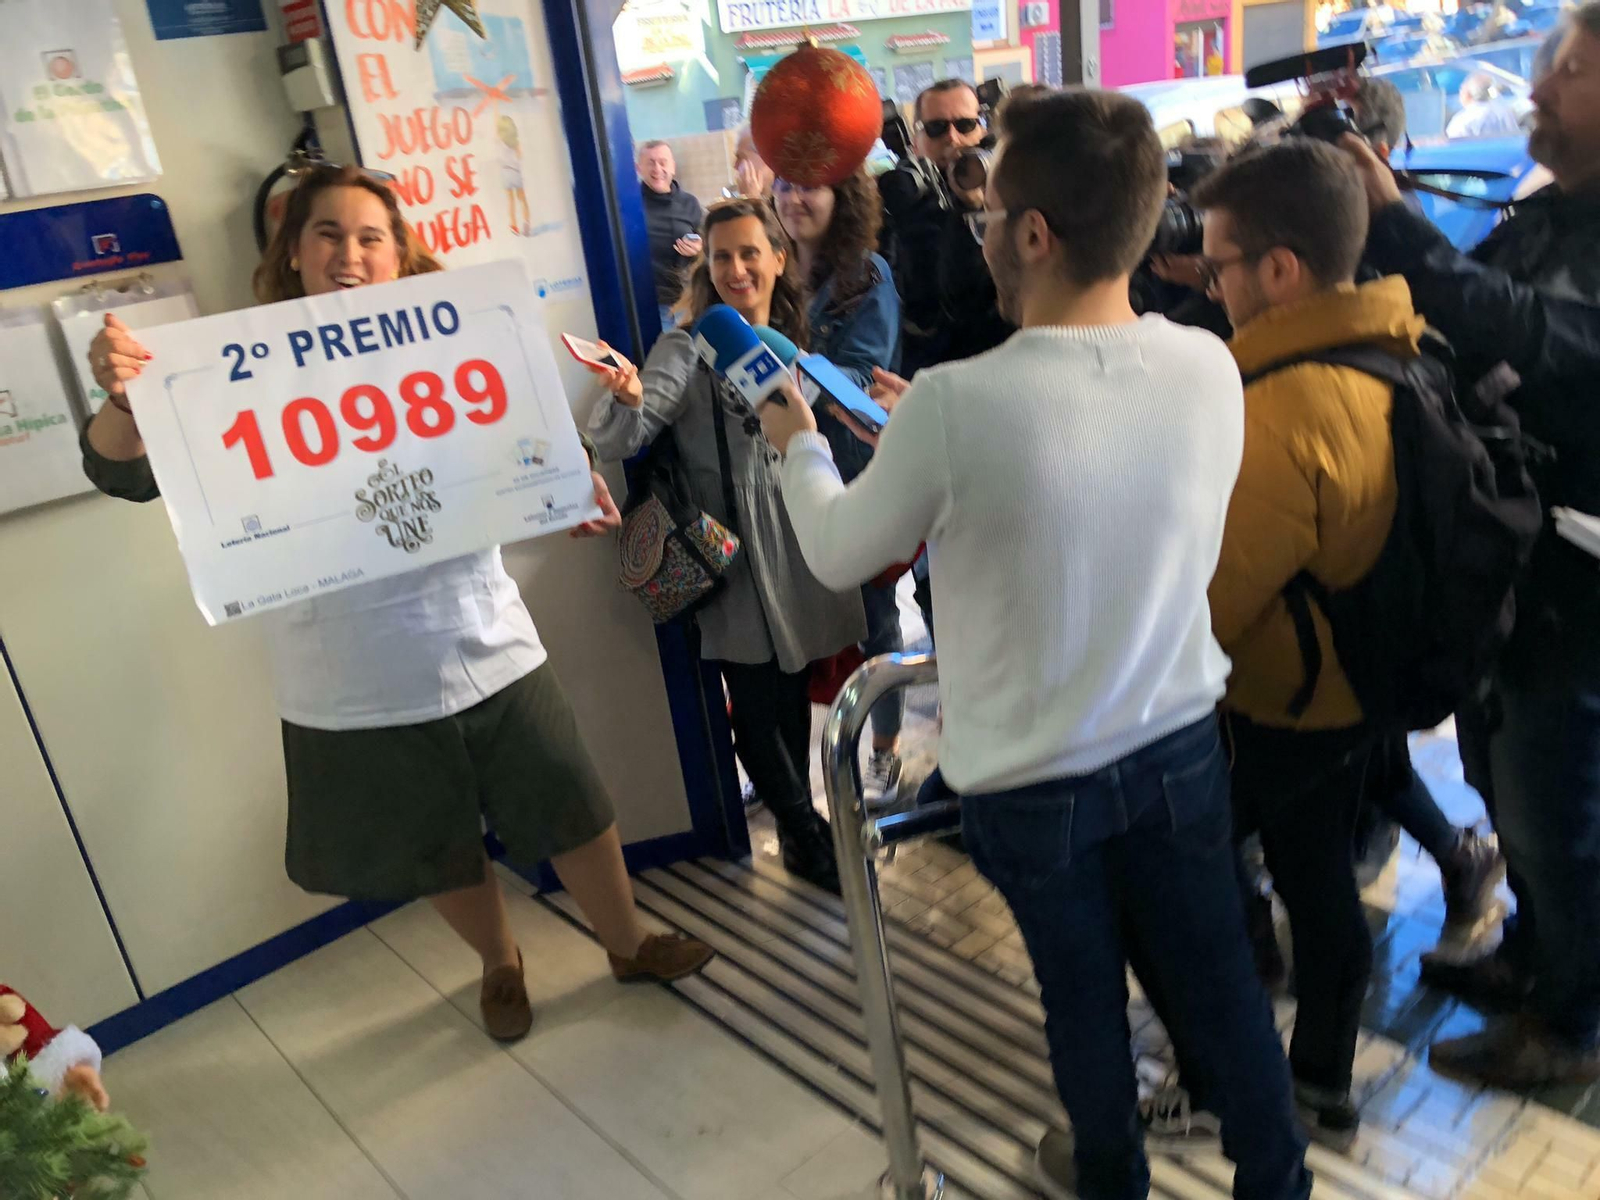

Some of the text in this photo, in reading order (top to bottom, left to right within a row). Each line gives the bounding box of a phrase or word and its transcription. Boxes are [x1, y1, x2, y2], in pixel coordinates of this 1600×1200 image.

[345, 0, 417, 43] CON
[356, 53, 399, 103] EL
[376, 106, 473, 160] JUEGO
[389, 153, 479, 207] NO SE
[408, 203, 492, 254] UEGA
[222, 300, 460, 383] 2º PREMIO
[221, 358, 509, 481] 10989
[355, 467, 434, 523] SORTEO
[375, 514, 434, 554] UNE
